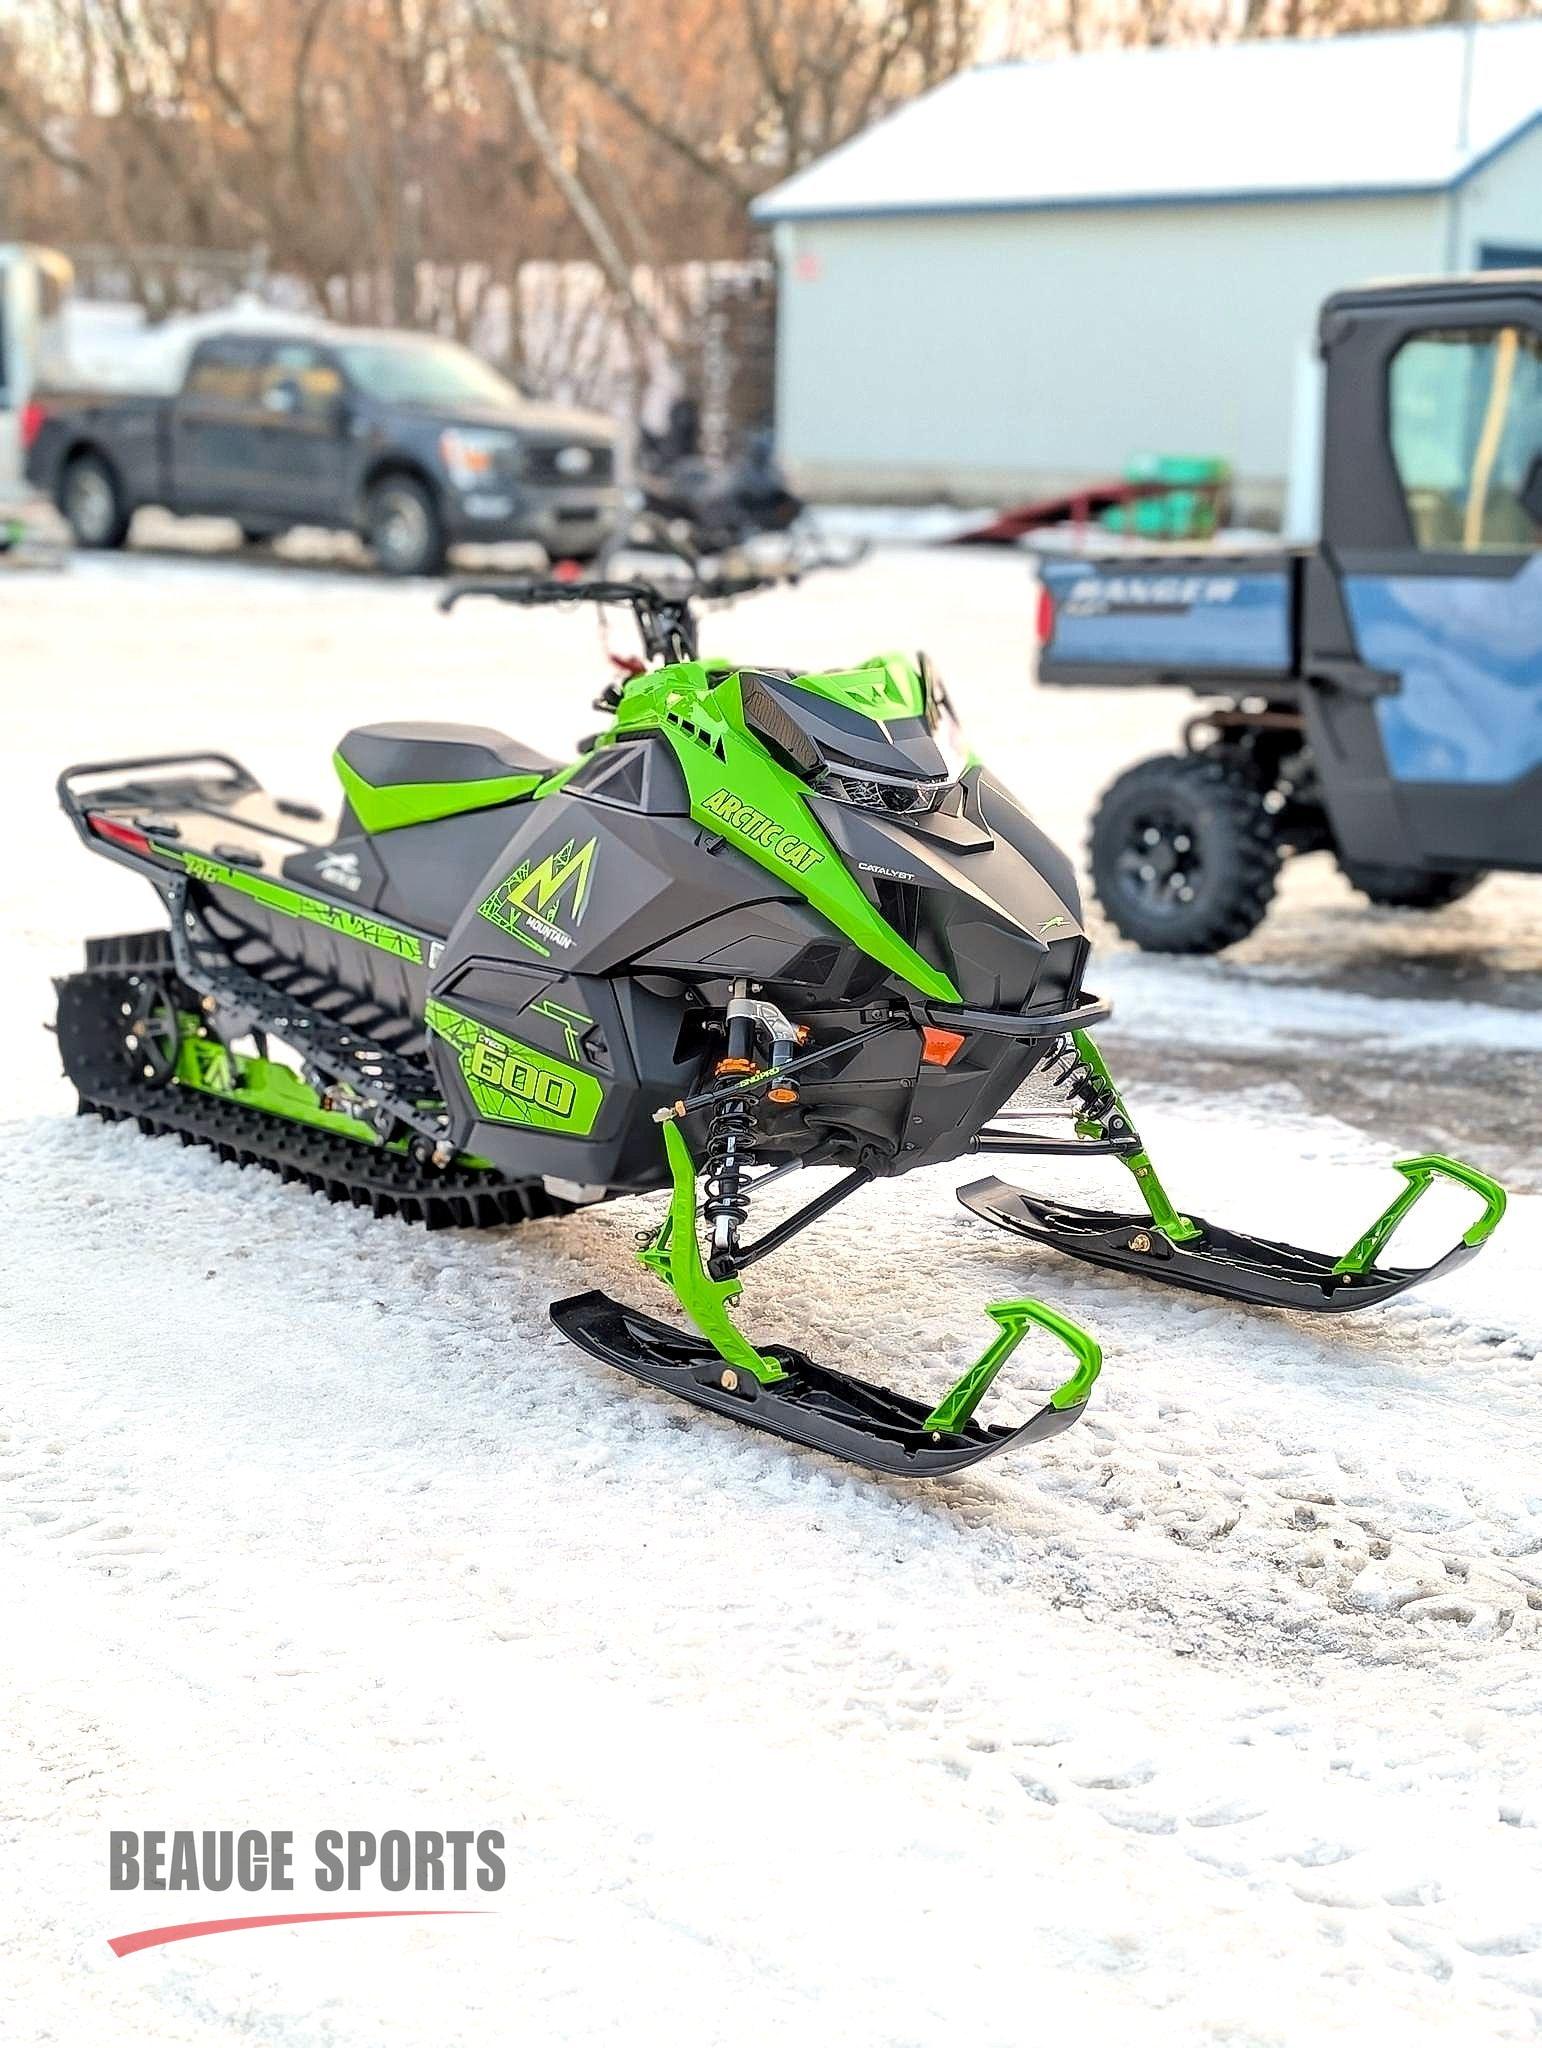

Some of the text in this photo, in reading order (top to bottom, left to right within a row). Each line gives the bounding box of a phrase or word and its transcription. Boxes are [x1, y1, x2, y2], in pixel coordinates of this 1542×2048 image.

[1070, 577, 1240, 602] RANGER
[701, 788, 826, 874] ARCTIC CAT
[858, 862, 916, 881] CATALYST
[526, 915, 573, 949] MOUNTAIN
[471, 1041, 575, 1118] 600
